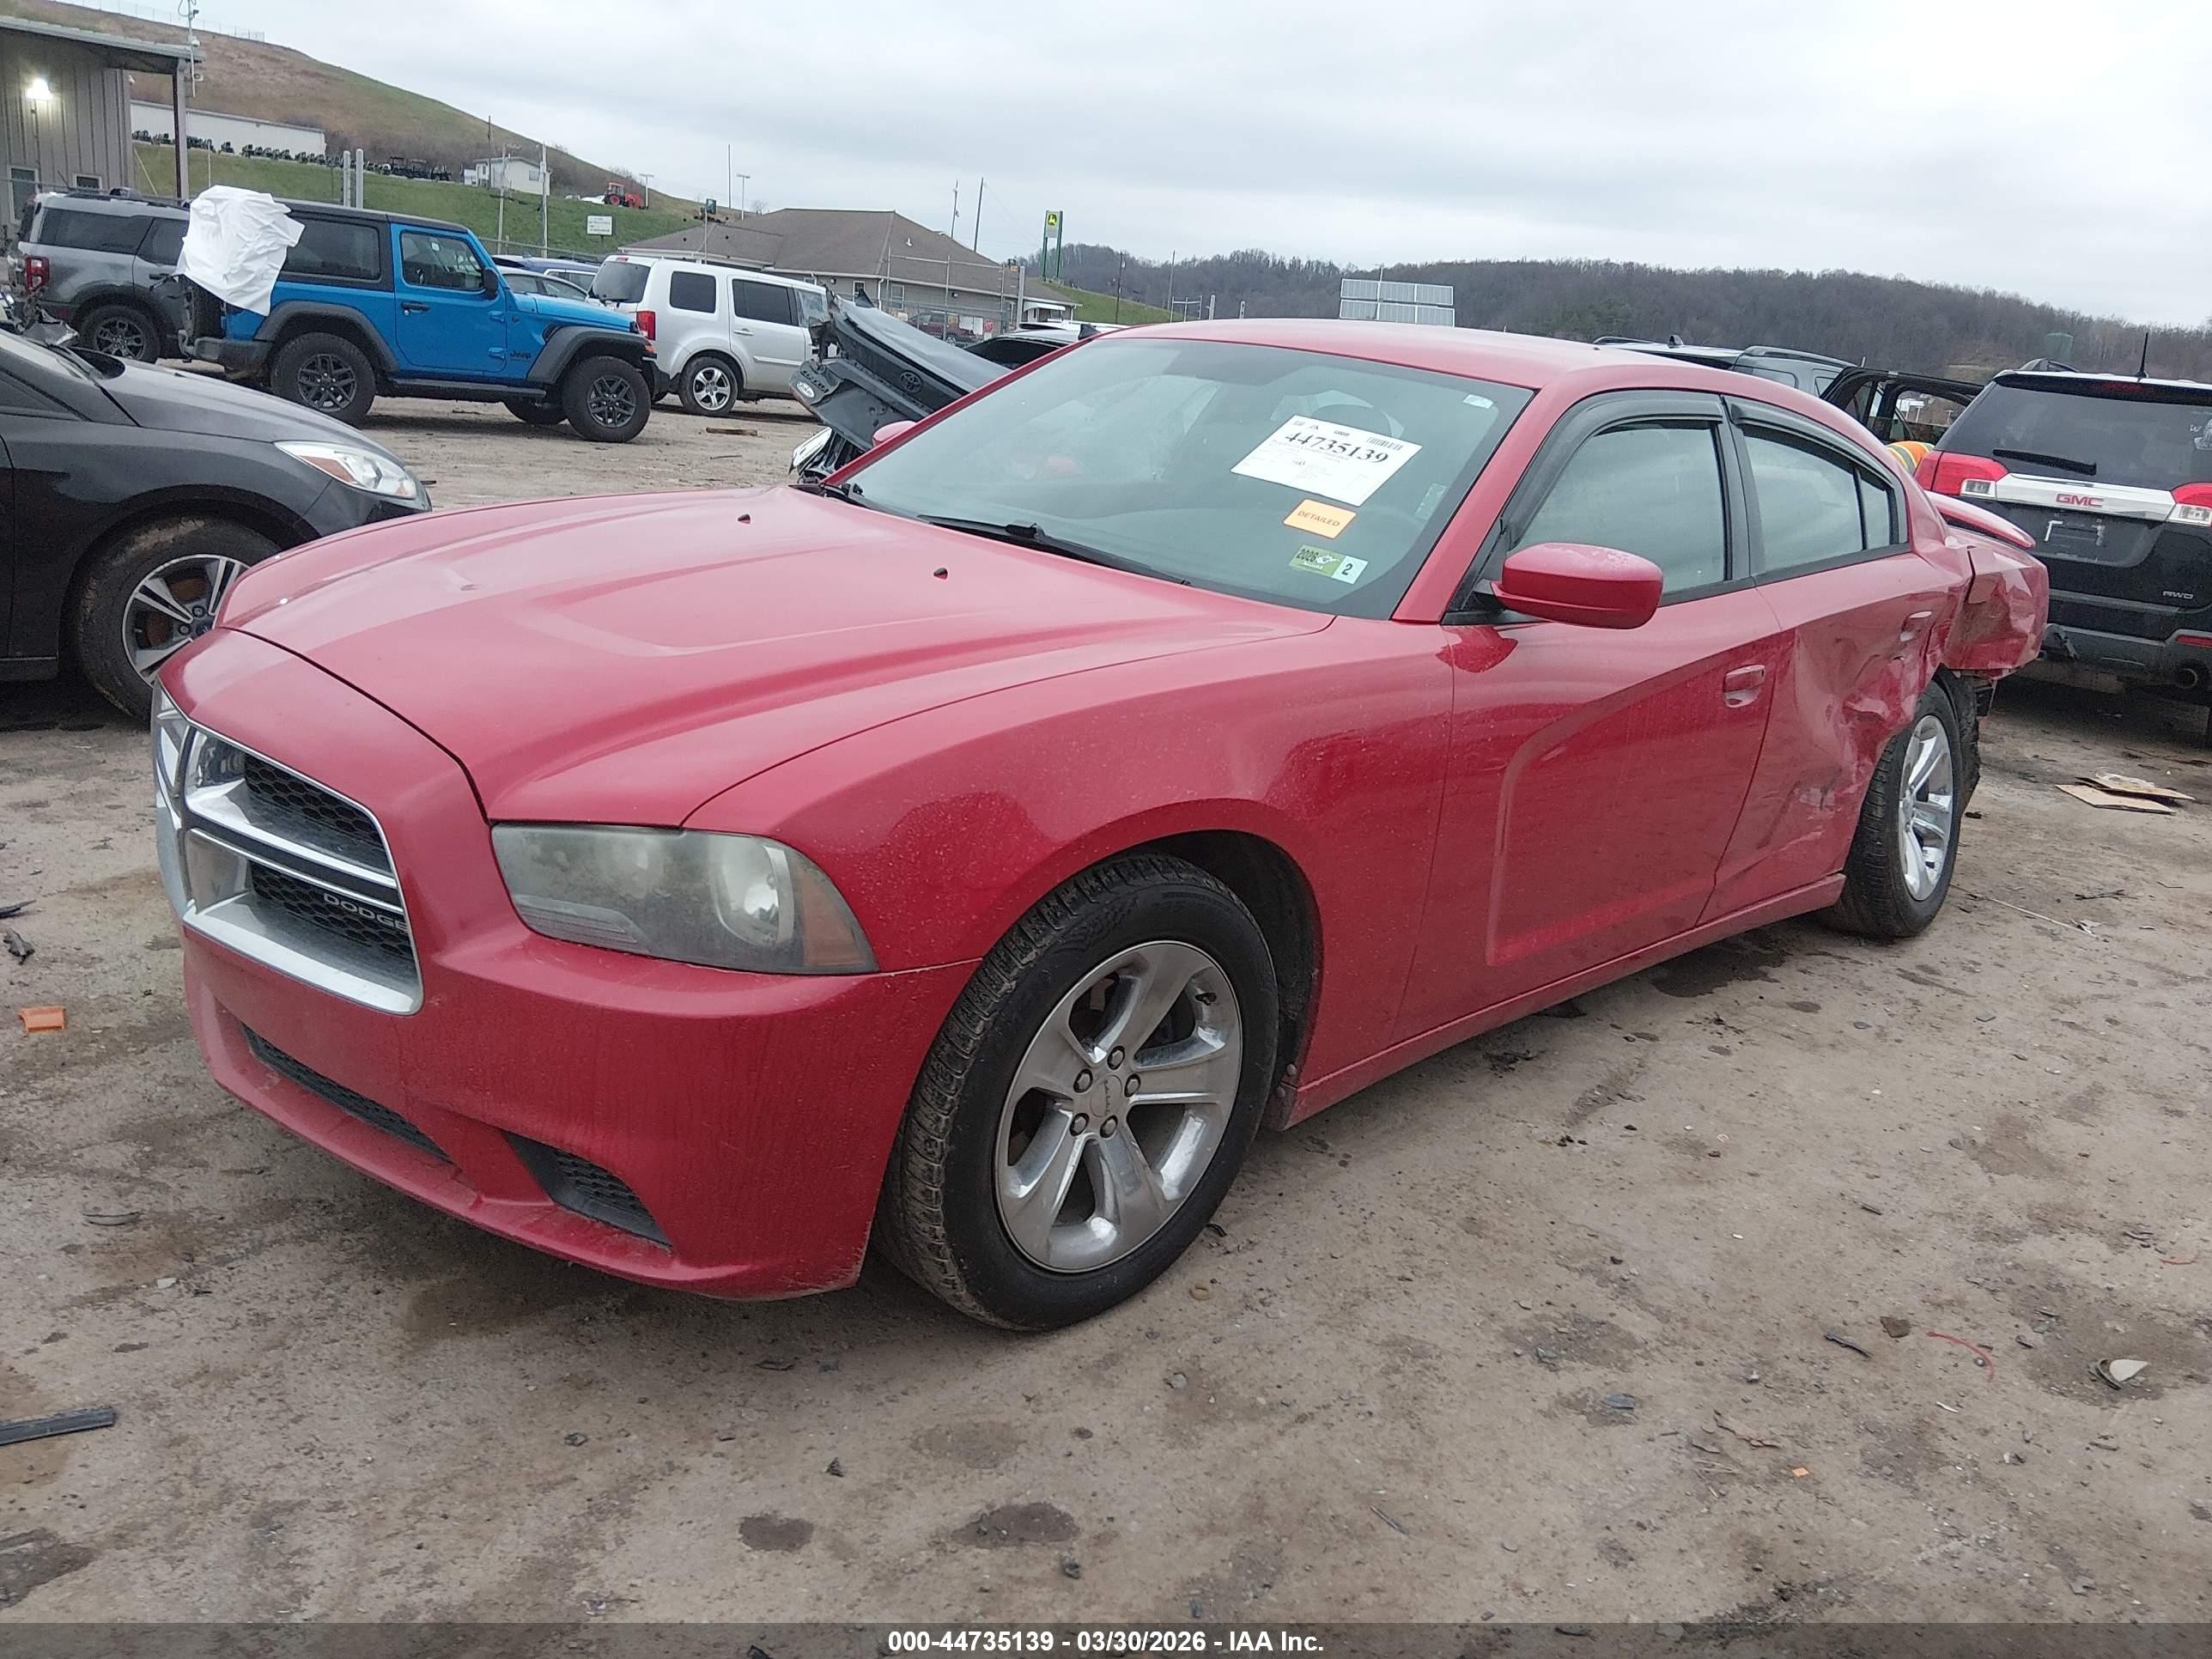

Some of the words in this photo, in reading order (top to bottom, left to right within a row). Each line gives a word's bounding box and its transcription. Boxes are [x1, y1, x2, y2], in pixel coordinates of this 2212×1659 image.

[510, 350, 531, 360] Jeep
[1285, 432, 1388, 463] 44735139
[2056, 493, 2104, 507] GMC
[1297, 510, 1340, 526] DETAILED
[1341, 562, 1353, 576] 2
[323, 893, 408, 932] DODGE
